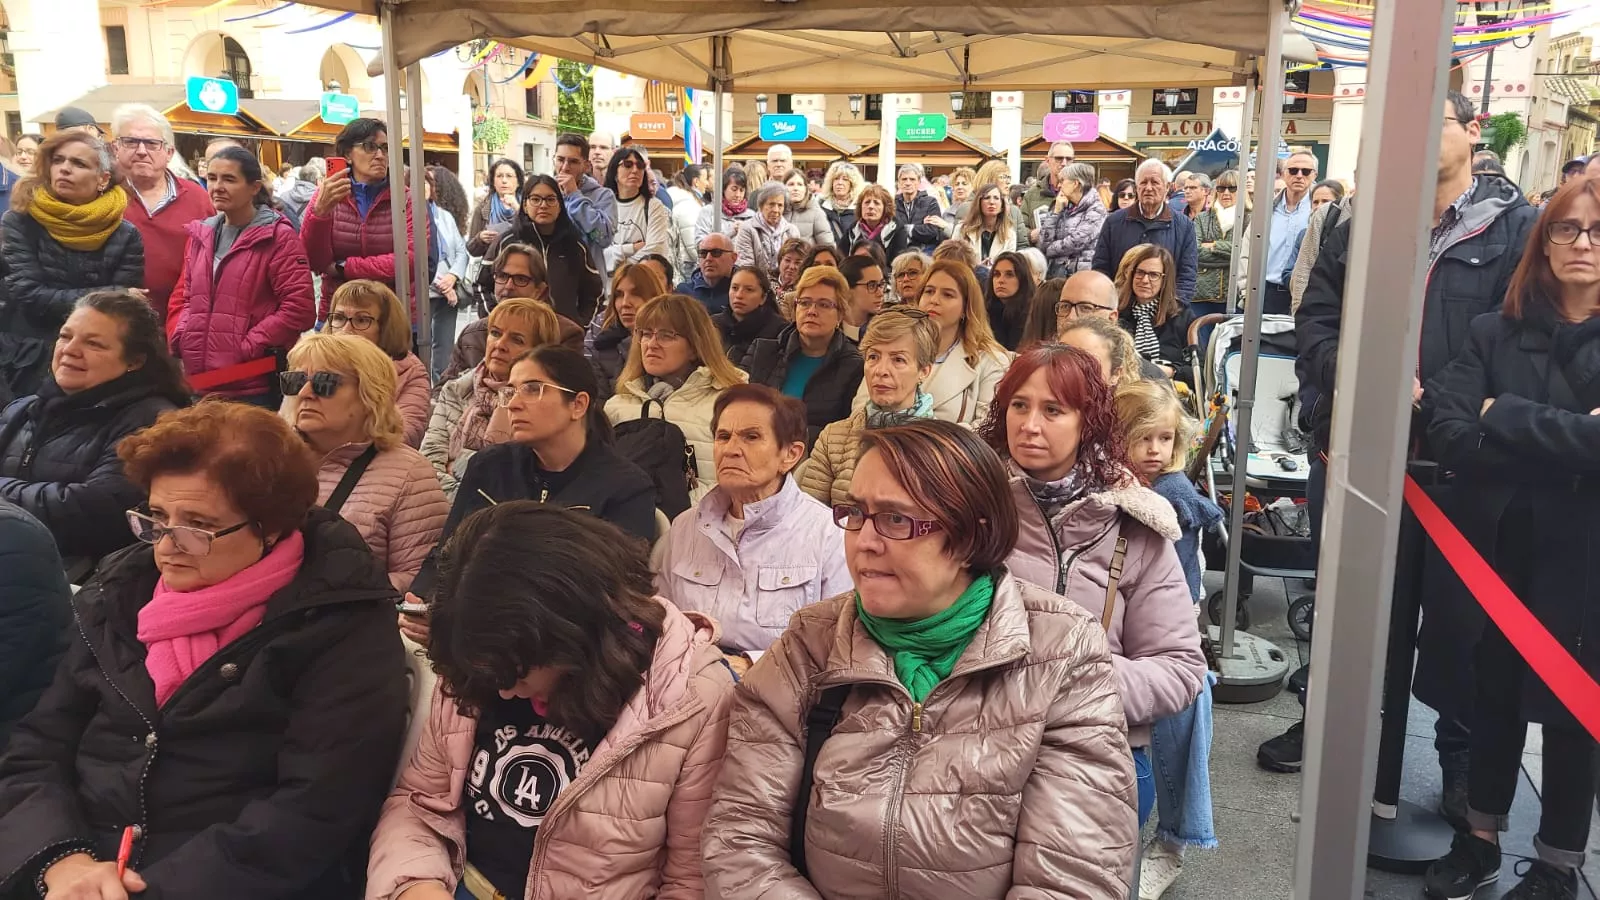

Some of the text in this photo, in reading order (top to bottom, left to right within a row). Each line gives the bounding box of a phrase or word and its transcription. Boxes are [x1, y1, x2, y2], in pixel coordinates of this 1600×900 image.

[917, 116, 926, 127] Z
[494, 725, 518, 754] LOS
[514, 765, 541, 811] LA
